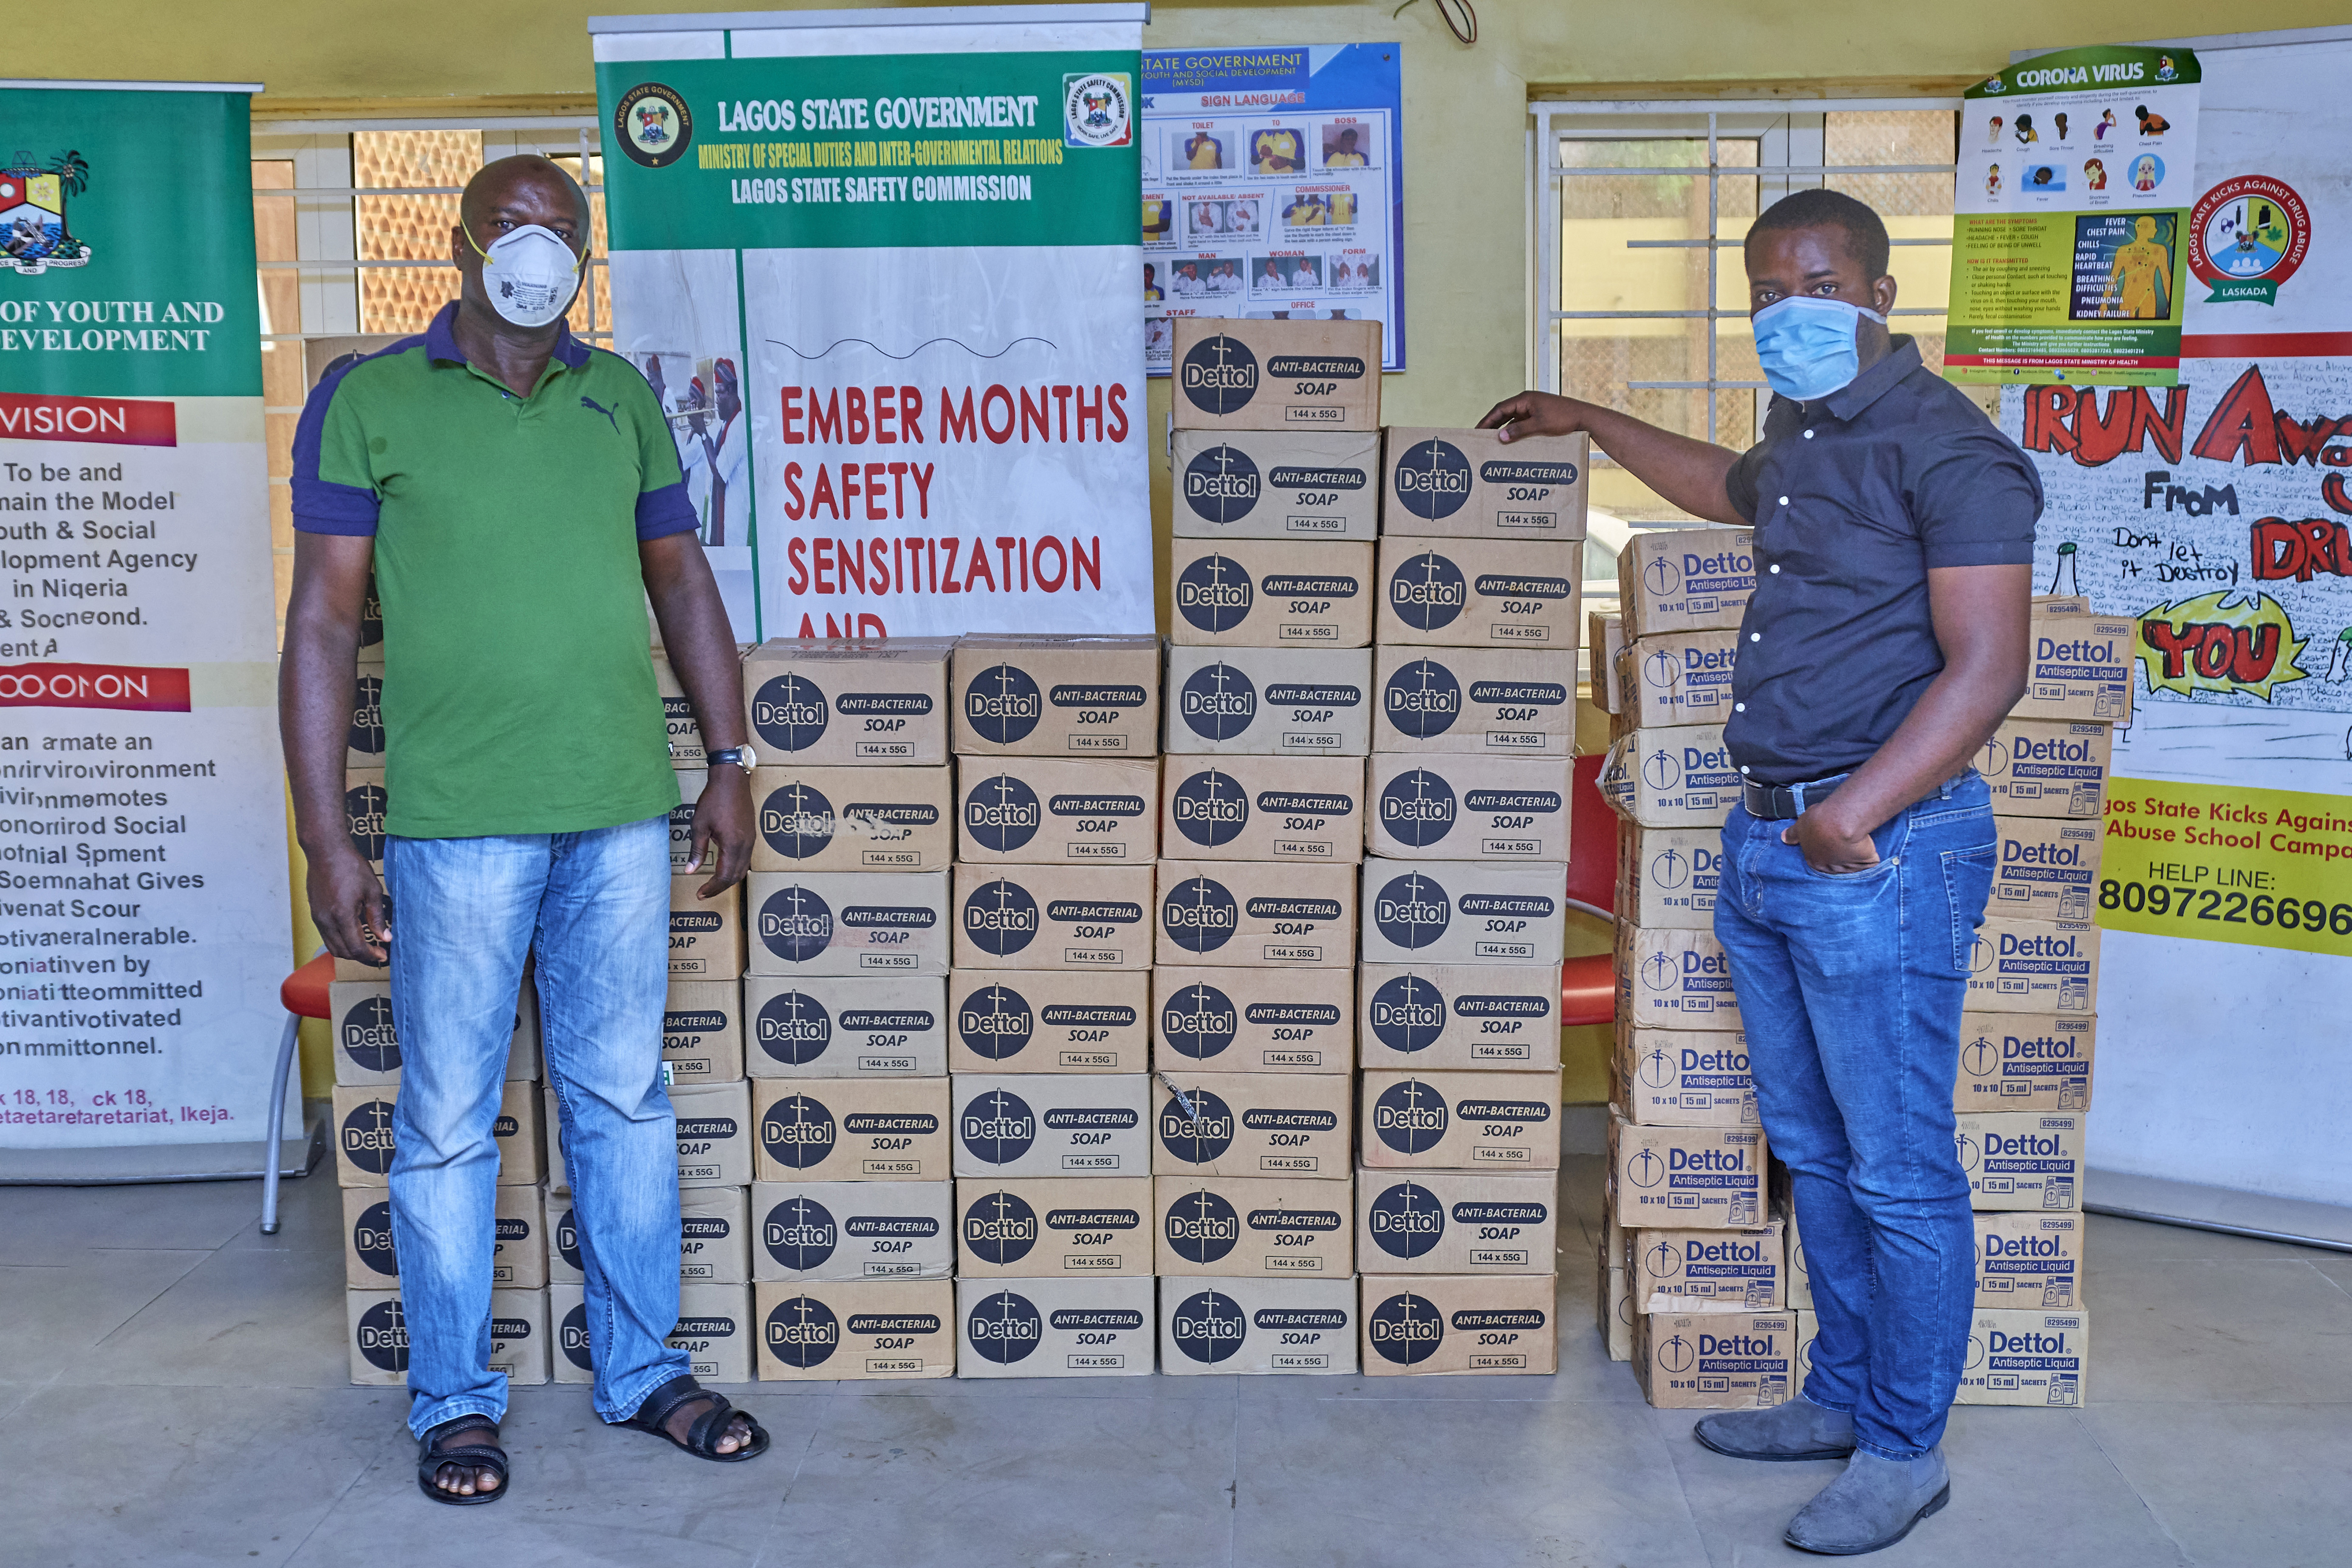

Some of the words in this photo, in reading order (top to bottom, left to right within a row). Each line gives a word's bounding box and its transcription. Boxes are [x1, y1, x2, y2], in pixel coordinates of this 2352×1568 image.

[1185, 54, 1302, 69] GOVERNMENT
[1231, 67, 1296, 76] DEVELOPMENT
[2016, 66, 2088, 87] CORONA
[2092, 62, 2144, 82] VIRUS
[1173, 78, 1204, 88] (MYSD)
[618, 100, 630, 127] LAGOS
[628, 86, 649, 101] STATE
[651, 86, 689, 126] GOVERNMENT
[1074, 85, 1088, 99] STATE
[1106, 82, 1125, 118] COMMISSION
[1201, 95, 1230, 107] SIGN
[1235, 92, 1305, 106] LANGUAGE
[718, 99, 796, 132] LAGOS
[801, 98, 869, 131] STATE
[874, 96, 1038, 129] GOVERNMENT
[698, 144, 750, 169] MINISTRY
[753, 144, 766, 168] OF
[768, 143, 812, 168] SPECIAL
[814, 142, 851, 167] DUTIES
[854, 141, 876, 167] AND
[879, 139, 1001, 166] INTER-GOVERNMENTAL
[1004, 138, 1063, 164] RELATIONS
[732, 178, 787, 203] LAGOS
[792, 177, 840, 203] STATE
[845, 177, 907, 202] SAFETY
[912, 175, 1031, 201] COMMISSION
[1295, 185, 1350, 193] COMMISSIONER
[2210, 182, 2240, 203] KICKS
[2244, 180, 2290, 199] AGAINST
[2106, 218, 2126, 226] FEVER
[2192, 201, 2211, 230] STATE
[2287, 198, 2306, 227] DRUG
[2078, 240, 2100, 249] CHILLS
[2190, 233, 2203, 267] LAGOS
[2289, 230, 2306, 265] ABUSE
[2075, 261, 2113, 269] HEARTBEAT
[2076, 284, 2117, 292] DIFFICULTIES
[2077, 275, 2115, 283] BREATHING
[2222, 287, 2267, 296] LASKADA
[0, 301, 39, 322] OF
[46, 301, 154, 322] YOUTH
[161, 302, 224, 323] AND
[1186, 364, 1254, 388] Dettol
[1272, 362, 1361, 373] ANTI-BACTERIAL
[1295, 383, 1337, 395] SOAP
[0, 406, 125, 433] VISION
[780, 385, 924, 444] EMBER
[939, 383, 1128, 444] MONTHS
[2022, 384, 2190, 467] RUN
[5, 463, 31, 482] To
[42, 463, 70, 482] be
[79, 463, 122, 482] and
[783, 461, 934, 521] SAFETY
[55, 492, 94, 510] the
[102, 492, 174, 510] Model
[56, 521, 74, 539] &
[82, 520, 155, 539] Social
[2112, 527, 2162, 549] Dont
[107, 550, 197, 573] Agency
[788, 535, 1101, 595] SENSITIZATION
[13, 579, 33, 597] in
[2096, 626, 2126, 635] 8295499
[2037, 637, 2113, 663] Dettol
[2142, 619, 2281, 684] YOU
[2039, 666, 2090, 678] Antiseptic
[2092, 668, 2123, 680] Liquid
[2039, 687, 2048, 696] 15
[2050, 688, 2060, 696] ml
[840, 698, 928, 709] ANTI-BACTERIAL
[757, 701, 824, 726] Dettol
[863, 718, 906, 732] SOAP
[863, 746, 879, 754] 144
[890, 746, 907, 754] 55G
[2145, 797, 2200, 819] State
[2210, 802, 2268, 825] Kicks
[113, 815, 186, 834] Social
[2106, 819, 2176, 842] Abuse
[2185, 826, 2261, 850] School
[136, 872, 204, 890] Gives
[2149, 861, 2209, 883] HELP
[2217, 867, 2276, 891] LINE:
[2098, 879, 2352, 935] 8097226696
[124, 955, 150, 977] by
[124, 1089, 153, 1107] 18,
[181, 1105, 234, 1125] Ikeja.
[1456, 1314, 1541, 1325] ANTI-BACTERIAL
[1373, 1318, 1439, 1342] Dettol
[1477, 1333, 1518, 1345] SOAP
[1699, 1334, 1772, 1356] Dettol
[1703, 1360, 1751, 1371] Antiseptic
[1754, 1361, 1784, 1371] Liquid
[1703, 1380, 1712, 1388] 15
